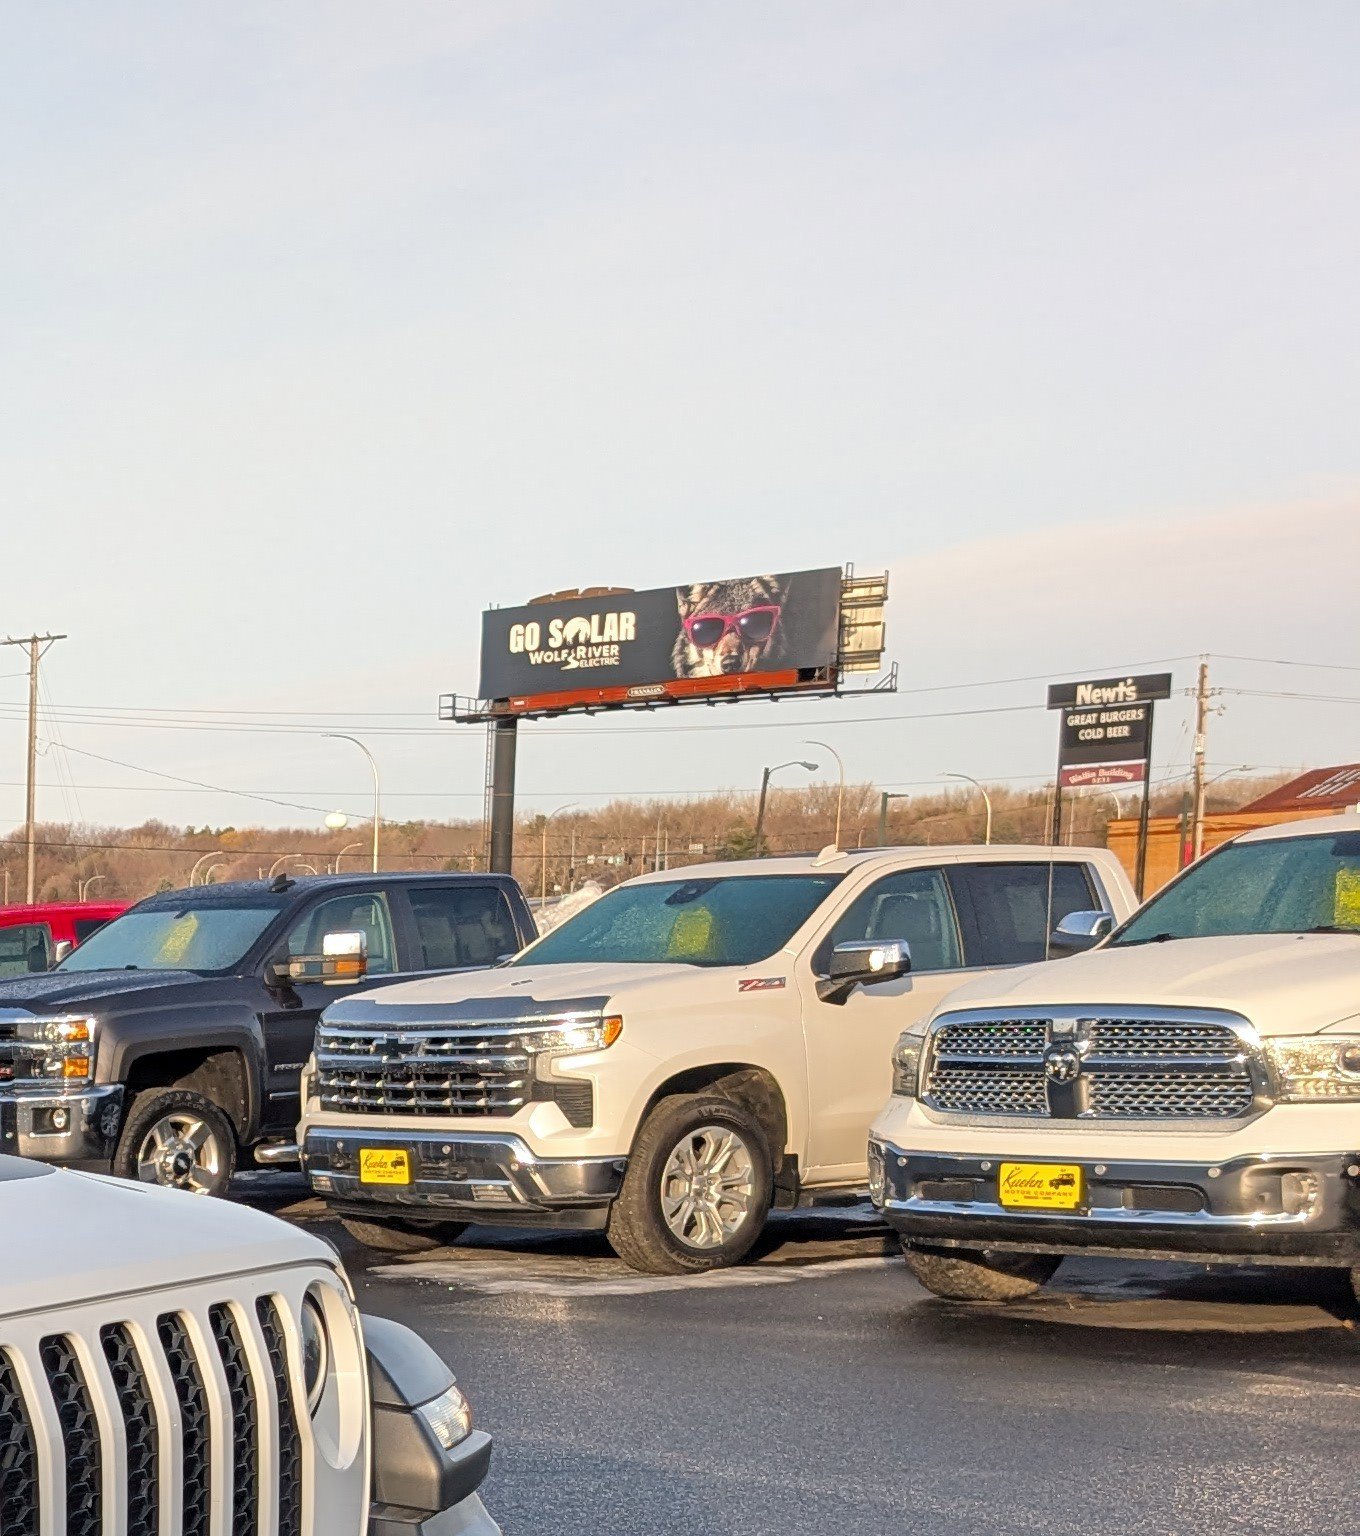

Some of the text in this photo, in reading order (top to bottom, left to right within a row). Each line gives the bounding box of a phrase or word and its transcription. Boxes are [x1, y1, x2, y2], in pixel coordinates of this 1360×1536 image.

[509, 622, 541, 653] GO
[529, 645, 620, 665] WOLF RIVER
[579, 657, 620, 668] ELECTRIC
[1076, 678, 1137, 705] Newt's
[1067, 709, 1144, 726] GREAT BURGERS
[1078, 725, 1130, 740] COLD BEER
[1002, 1169, 1043, 1188] Kuehn
